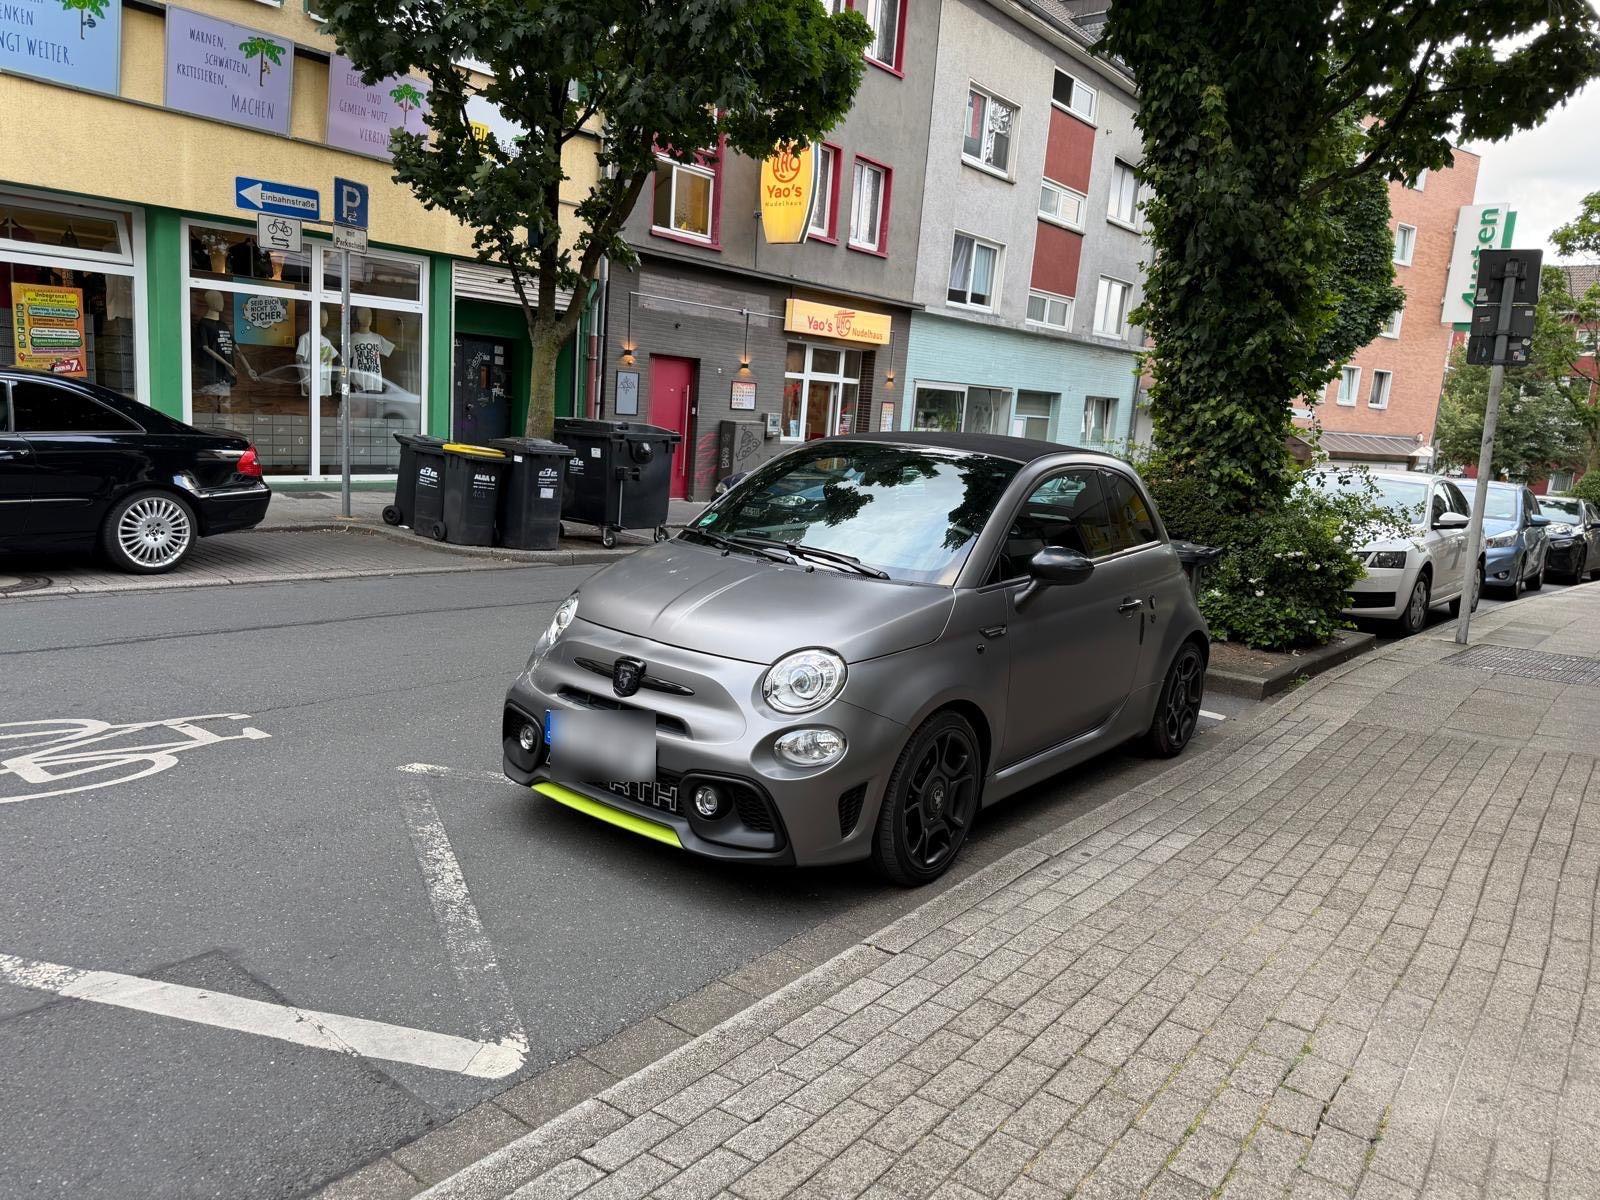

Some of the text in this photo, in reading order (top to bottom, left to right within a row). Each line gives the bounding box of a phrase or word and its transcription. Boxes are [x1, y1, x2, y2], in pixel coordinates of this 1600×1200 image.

[26, 35, 74, 66] WEITER.
[366, 92, 382, 105] UND
[231, 94, 275, 120] MACHEN
[767, 184, 802, 198] Yao's
[260, 192, 315, 209] Einbahnstraße
[342, 185, 361, 219] P
[264, 298, 279, 306] EUCH
[269, 304, 278, 312] SO
[250, 311, 282, 322] SICHER
[807, 315, 833, 333] Yao's
[851, 327, 883, 341] Nudelhaus
